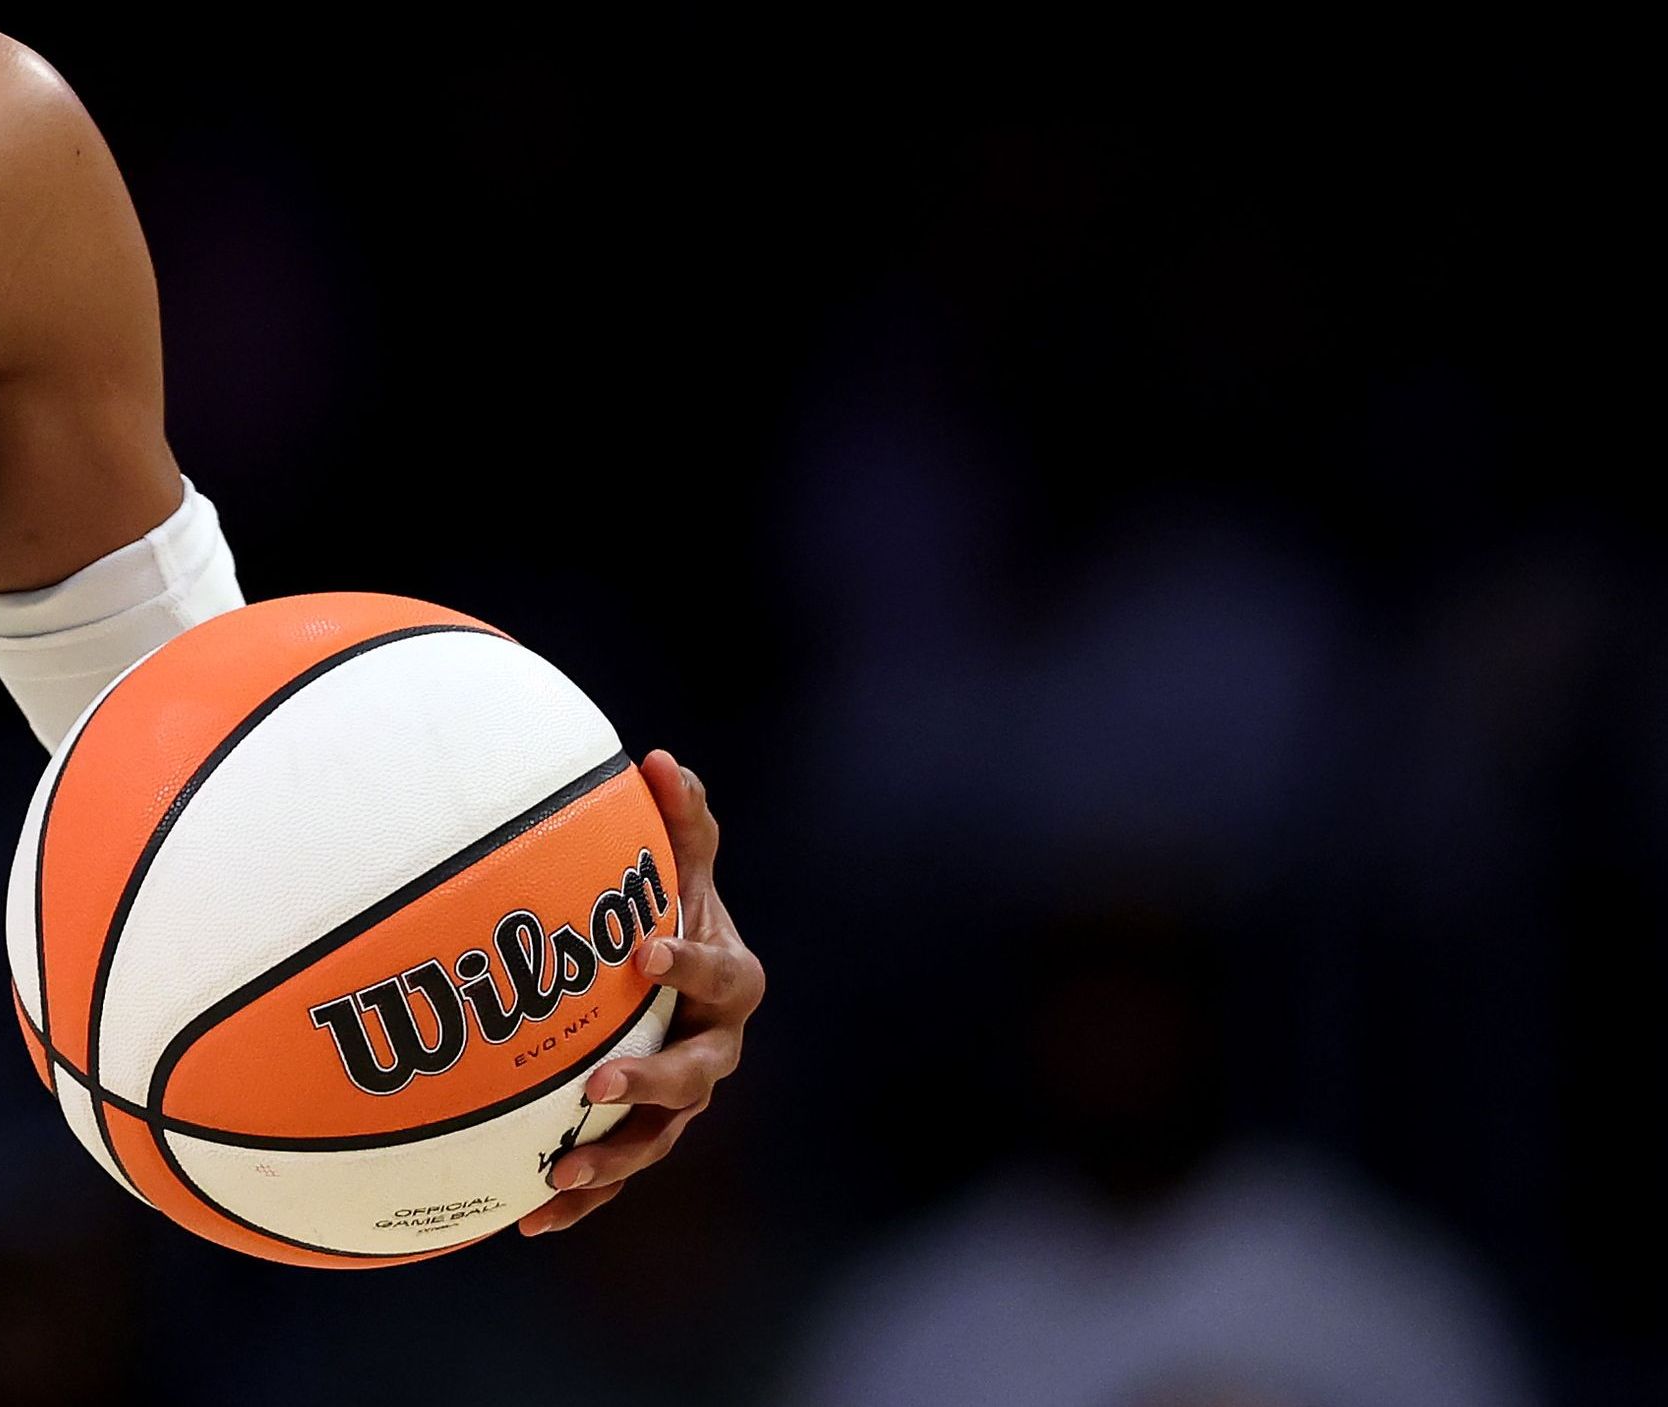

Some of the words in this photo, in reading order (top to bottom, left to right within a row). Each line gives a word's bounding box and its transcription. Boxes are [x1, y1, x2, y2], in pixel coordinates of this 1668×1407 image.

[307, 847, 670, 1096] Wilson
[514, 1037, 556, 1067] EVO
[564, 1006, 599, 1039] NXT
[375, 1215, 445, 1228] GAME
[450, 1202, 506, 1221] BALL
[394, 1195, 497, 1218] OFFICIAL
